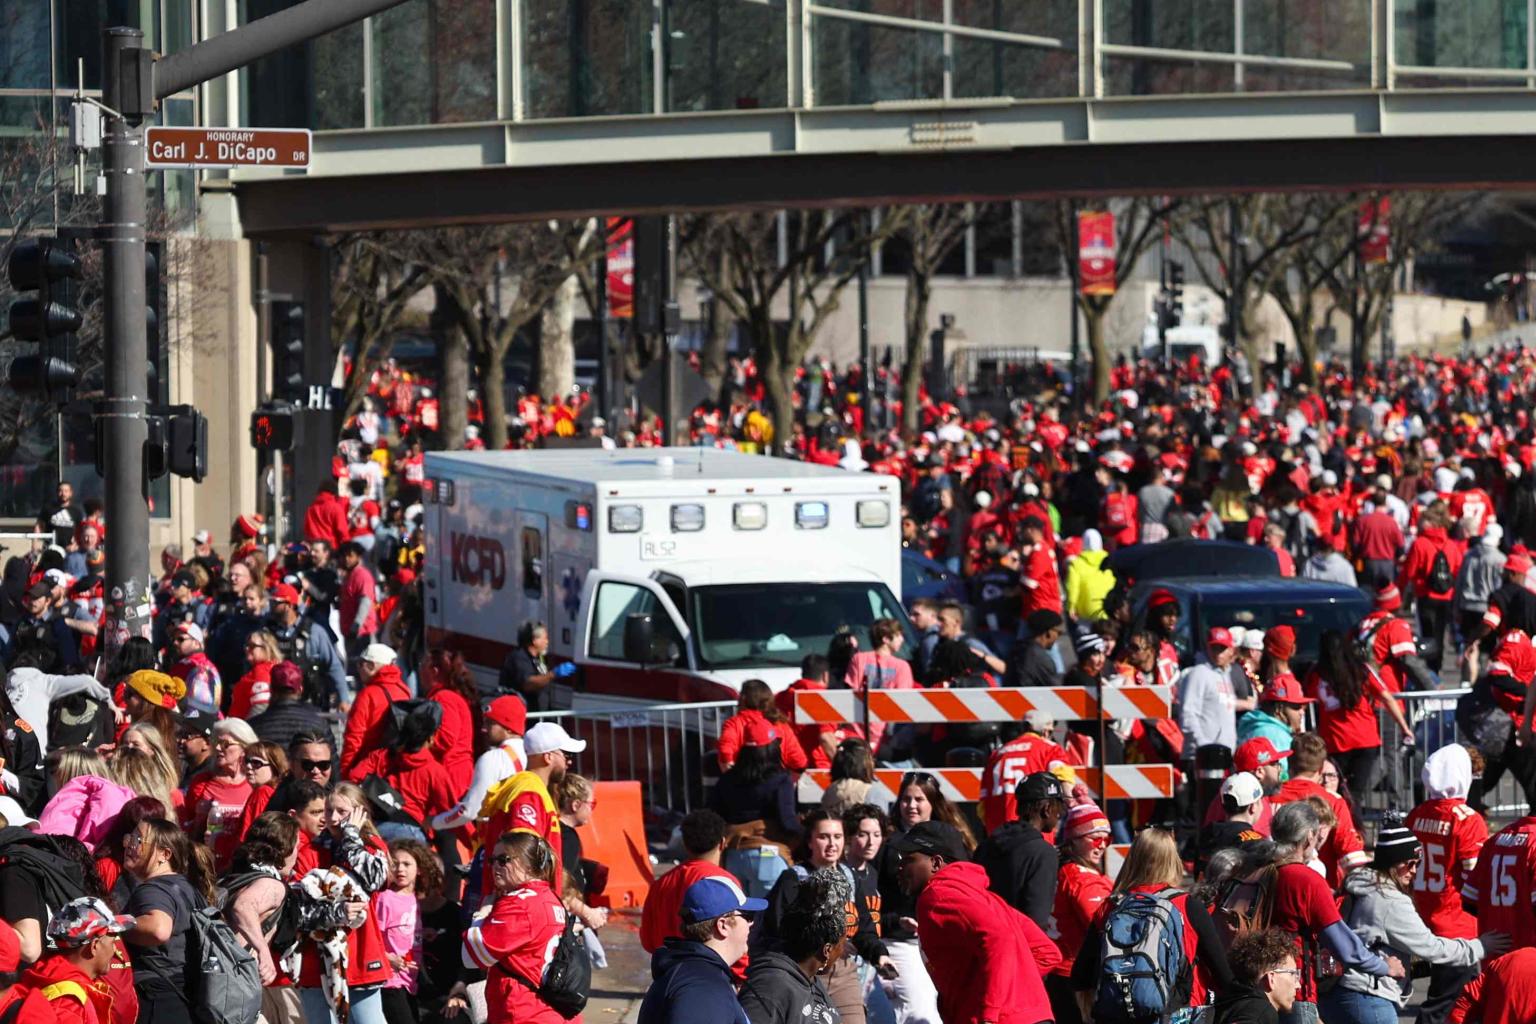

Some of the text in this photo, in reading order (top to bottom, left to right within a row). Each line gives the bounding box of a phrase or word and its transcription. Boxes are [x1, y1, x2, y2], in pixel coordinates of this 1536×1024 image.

[152, 141, 306, 164] Carl J. DiCapo DR
[206, 131, 255, 142] HONORARY
[451, 531, 507, 591] KCFD
[993, 756, 1026, 794] 15
[1413, 842, 1446, 893] 15
[1491, 854, 1517, 907] 15
